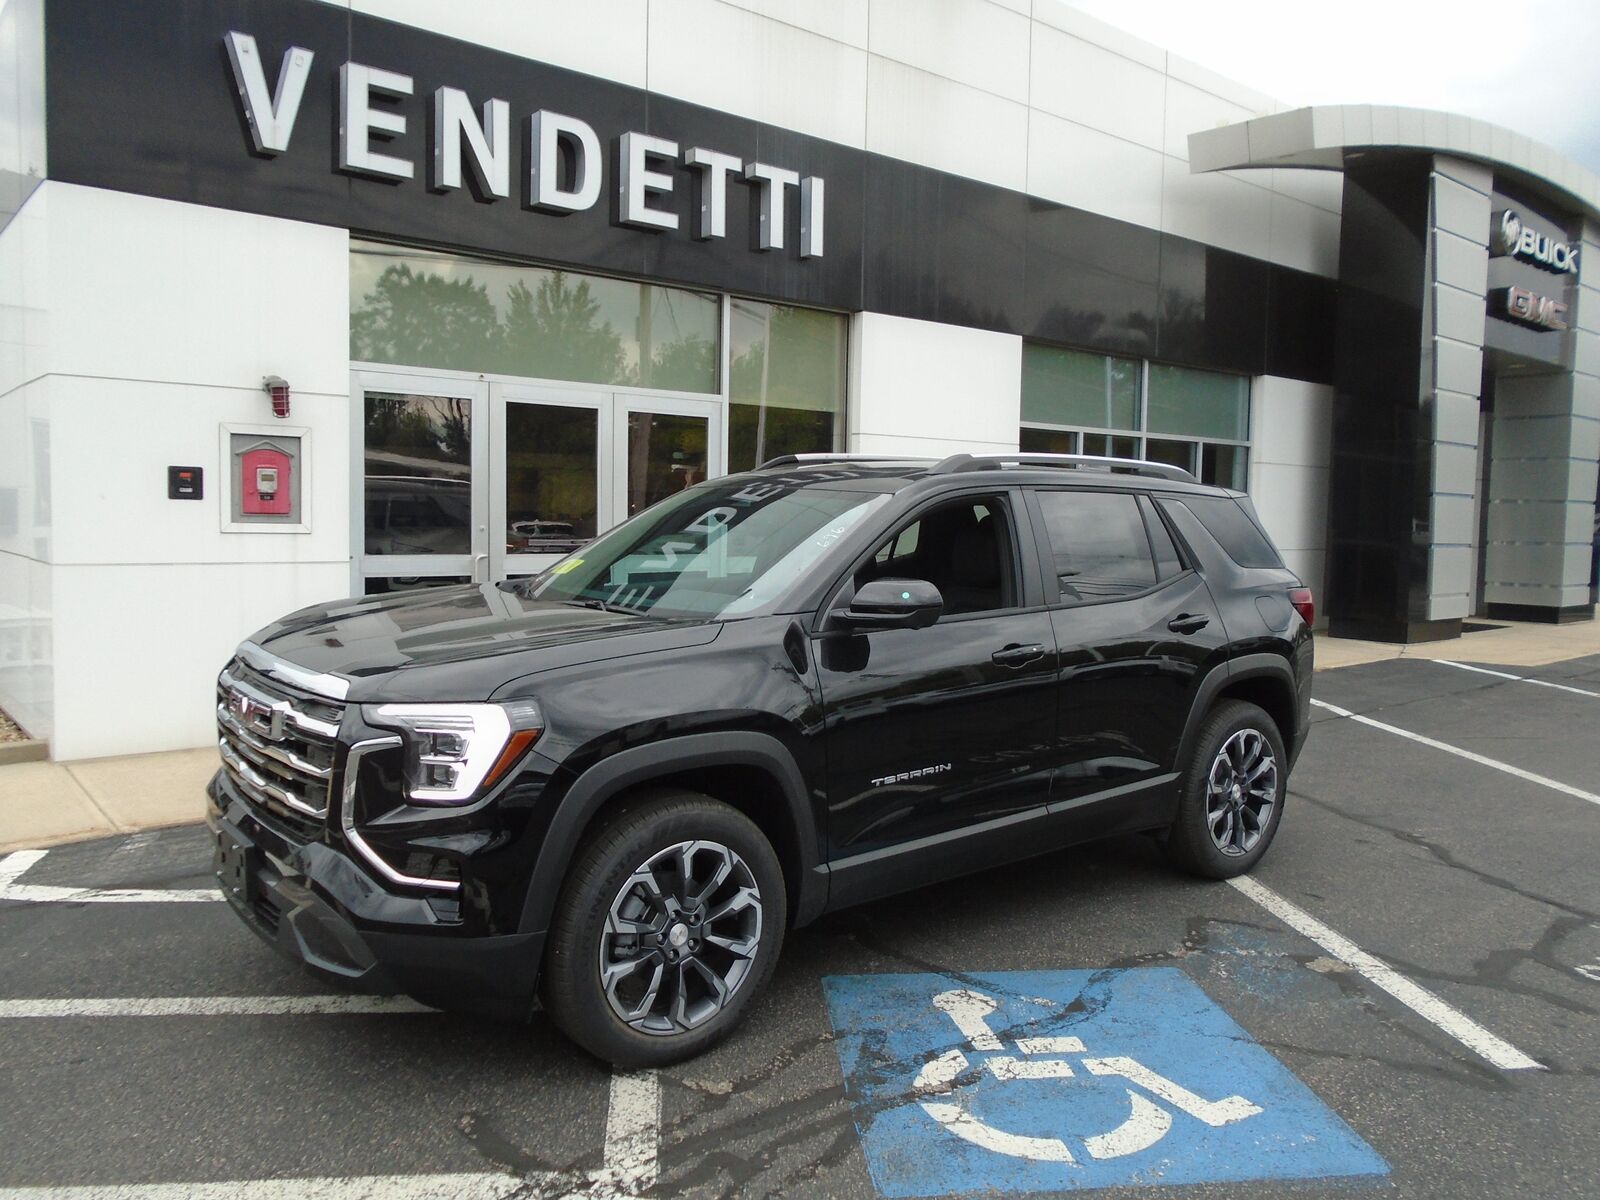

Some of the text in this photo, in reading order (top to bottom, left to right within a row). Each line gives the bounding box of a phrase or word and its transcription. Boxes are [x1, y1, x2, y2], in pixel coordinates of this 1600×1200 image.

[224, 30, 825, 259] VENDETTI
[1519, 226, 1579, 274] BUICK
[1507, 286, 1568, 330] GMC
[871, 762, 952, 788] TERRAIN
